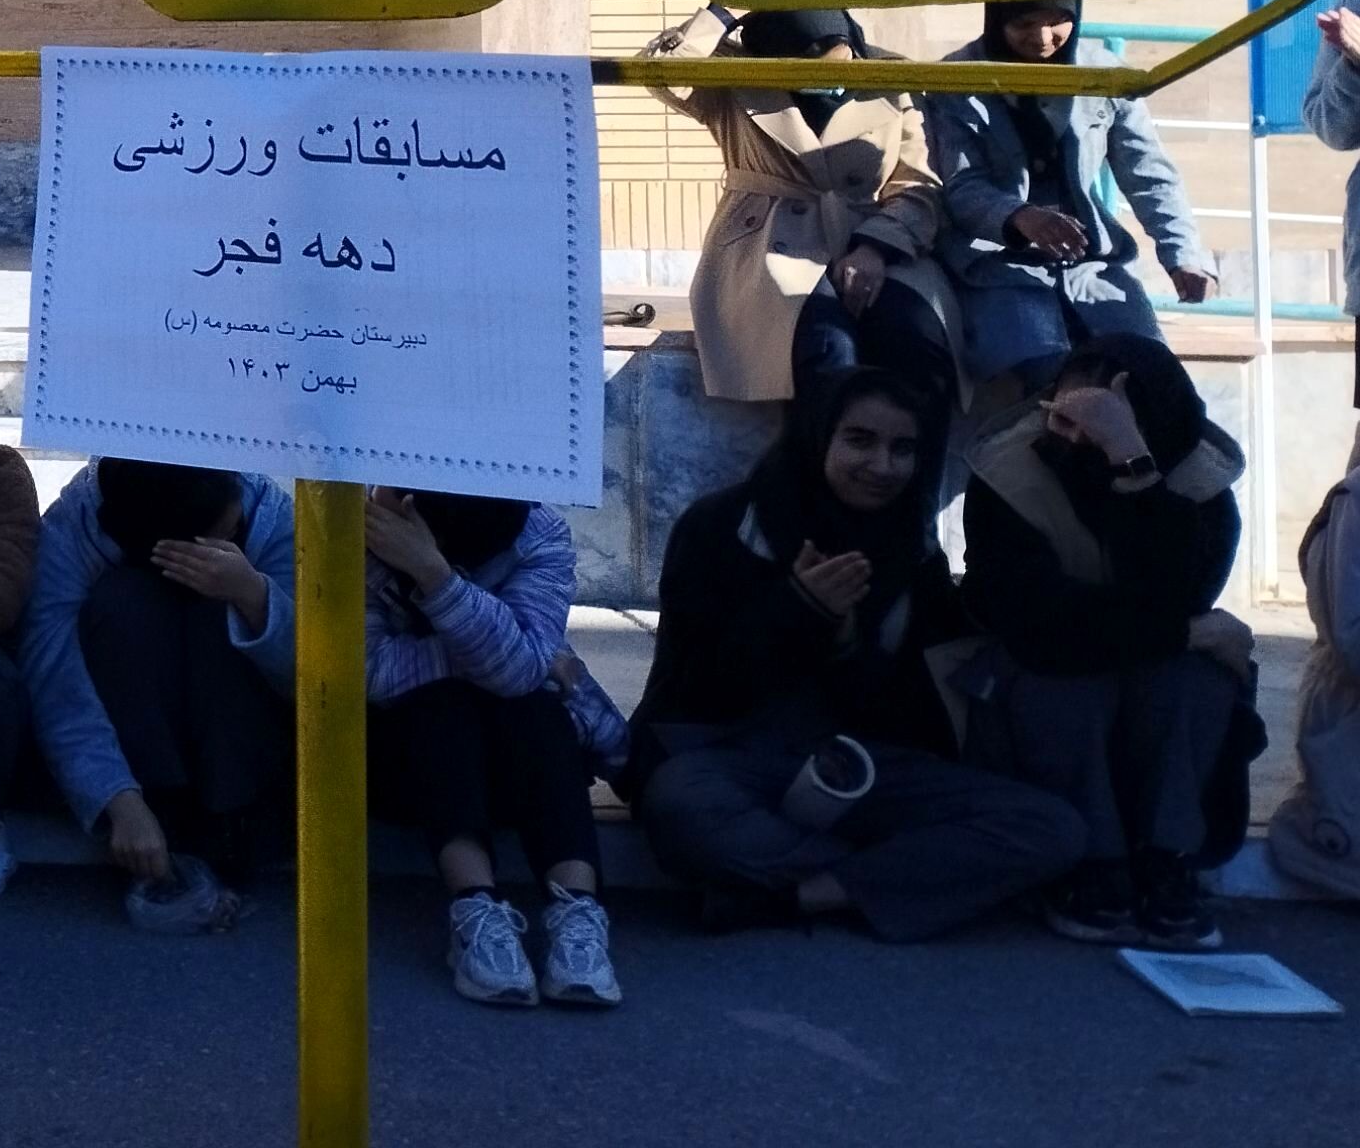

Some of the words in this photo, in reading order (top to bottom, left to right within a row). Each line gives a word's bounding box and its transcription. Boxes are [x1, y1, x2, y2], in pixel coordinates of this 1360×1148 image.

[113, 112, 277, 177] ورزشی
[298, 116, 506, 181] مسابقات
[192, 217, 282, 277] فجر
[301, 232, 396, 272] دهه
[164, 308, 198, 335] (س)
[203, 316, 270, 335] معصومه
[276, 320, 344, 342] حضرت
[351, 324, 427, 349] دبیرستان
[228, 357, 290, 381] ۱۴۰۳
[301, 370, 357, 395] بهمن
